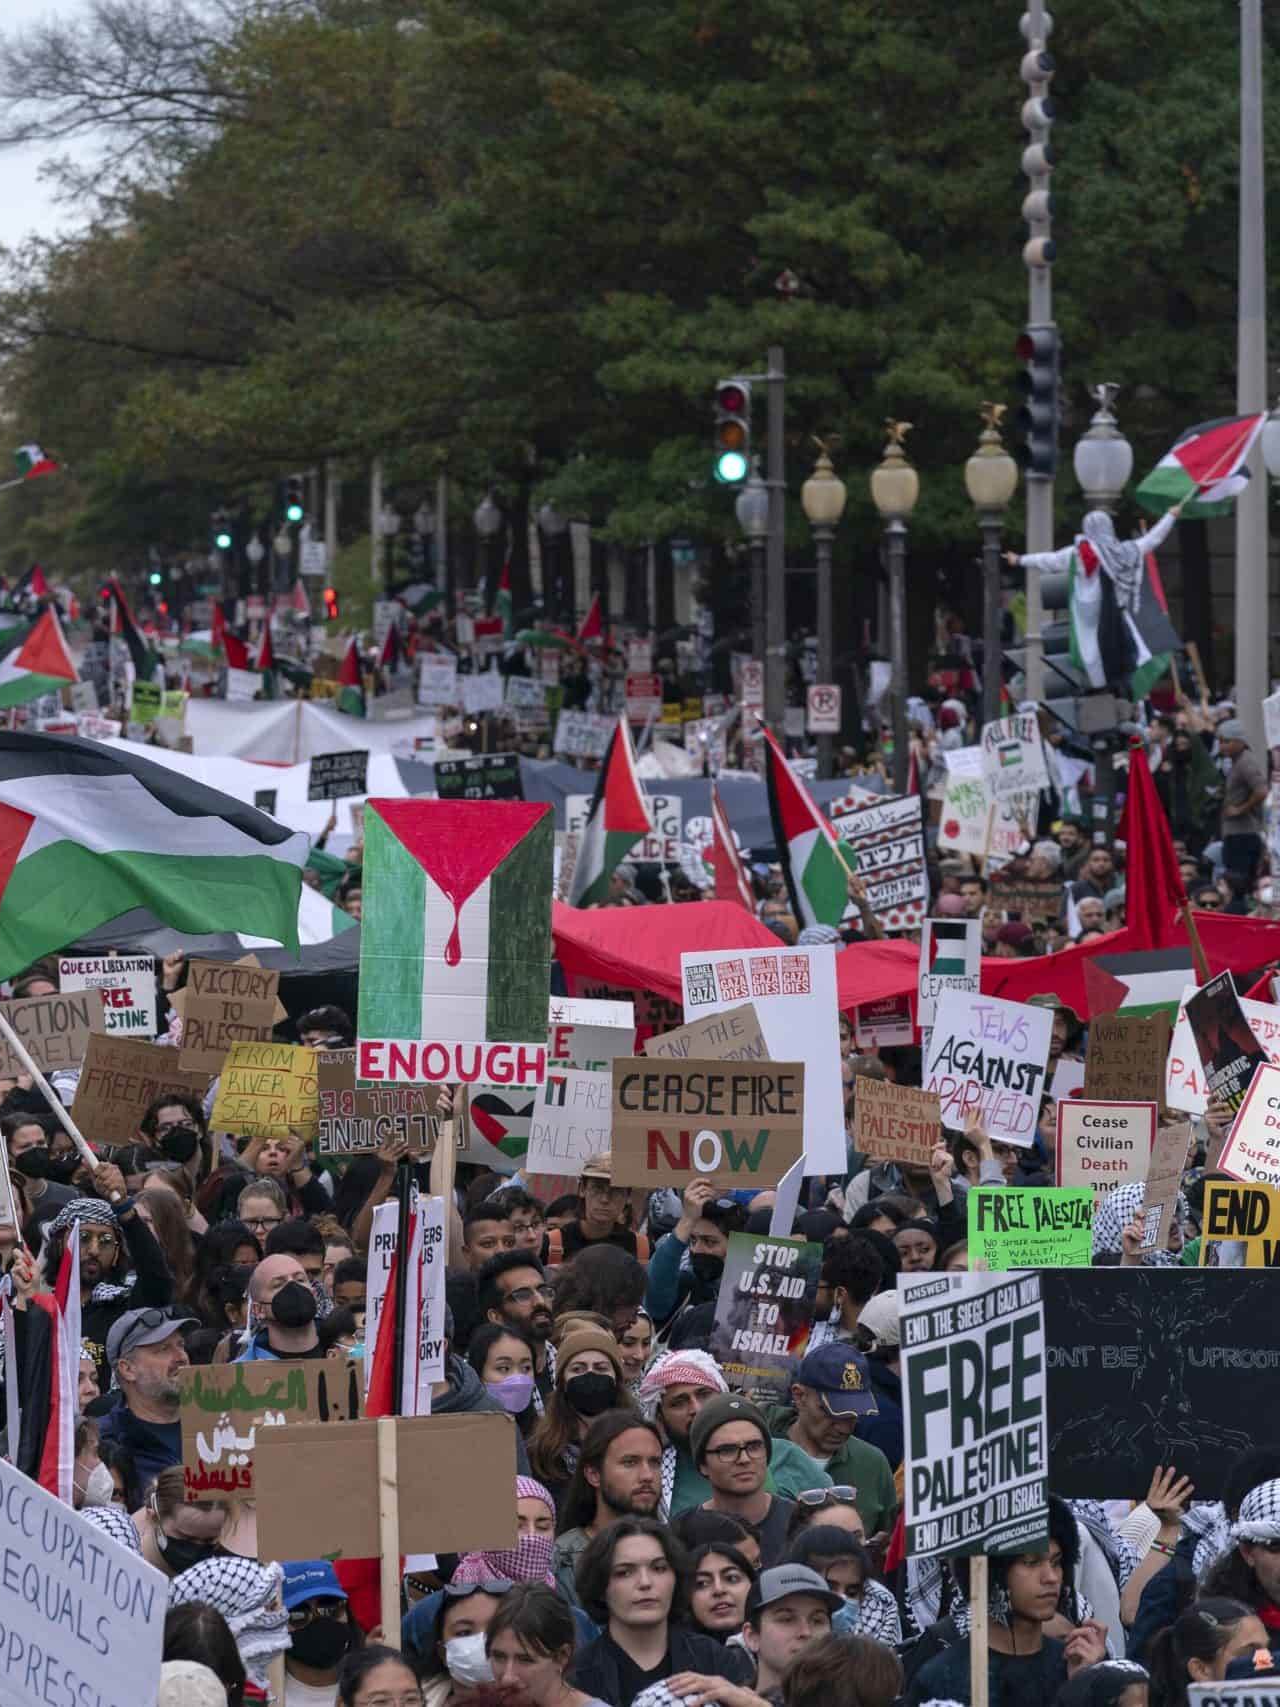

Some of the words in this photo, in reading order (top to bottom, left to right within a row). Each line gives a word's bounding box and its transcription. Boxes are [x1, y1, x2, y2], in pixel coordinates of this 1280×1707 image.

[60, 959, 102, 975] QUEER
[102, 958, 154, 973] LIBERATION
[752, 973, 778, 986] GAZA
[783, 971, 809, 984] GAZA
[191, 966, 277, 1000] VICTORY
[689, 986, 717, 1004] GAZA
[720, 977, 746, 991] GAZA
[722, 987, 748, 1001] DIES
[753, 983, 779, 996] DIES
[783, 982, 810, 996] DIES
[101, 988, 134, 1008] REE
[221, 1001, 243, 1021] TO
[700, 1016, 746, 1046] THE
[969, 1004, 1032, 1053] JEWS
[231, 1046, 295, 1067] FROM
[359, 1040, 546, 1085] ENOUGH
[930, 1034, 1044, 1097] AGAINST
[85, 1069, 140, 1102] FREE
[227, 1071, 285, 1094] RIVER
[572, 1080, 611, 1108] FRE
[620, 1073, 798, 1116] CEASEFIRE
[220, 1099, 259, 1122] SEA
[319, 1089, 357, 1117] BE
[368, 1088, 429, 1115] WILL
[879, 1102, 900, 1116] THE
[903, 1104, 928, 1121] SEA
[927, 1076, 1035, 1134] APARTHEID
[1081, 1114, 1129, 1129] Cease
[646, 1127, 771, 1172] NOW
[1076, 1135, 1134, 1151] Civilian
[1080, 1157, 1128, 1172] Death
[1090, 1178, 1119, 1193] and
[976, 1193, 1030, 1233] FREE
[1208, 1188, 1271, 1236] END
[752, 1243, 800, 1269] STOP
[983, 1238, 998, 1249] NO
[739, 1273, 773, 1295] U.S.
[777, 1276, 807, 1299] AID
[907, 1281, 948, 1301] ANSWER
[755, 1302, 781, 1326] TO
[905, 1315, 930, 1345] END
[931, 1307, 955, 1338] THE
[956, 1298, 985, 1330] SIEGE
[997, 1283, 1019, 1316] GAZA
[731, 1327, 791, 1357] ISRAEL
[906, 1311, 1043, 1462] FREE
[911, 1421, 1045, 1517] PALESTINE!
[914, 1521, 939, 1553] END
[940, 1513, 961, 1546] ALL
[961, 1505, 982, 1537] U.S.
[995, 1493, 1009, 1521] TO
[1011, 1481, 1048, 1517] ISRAEL
[2, 1547, 113, 1656] EQUALS
